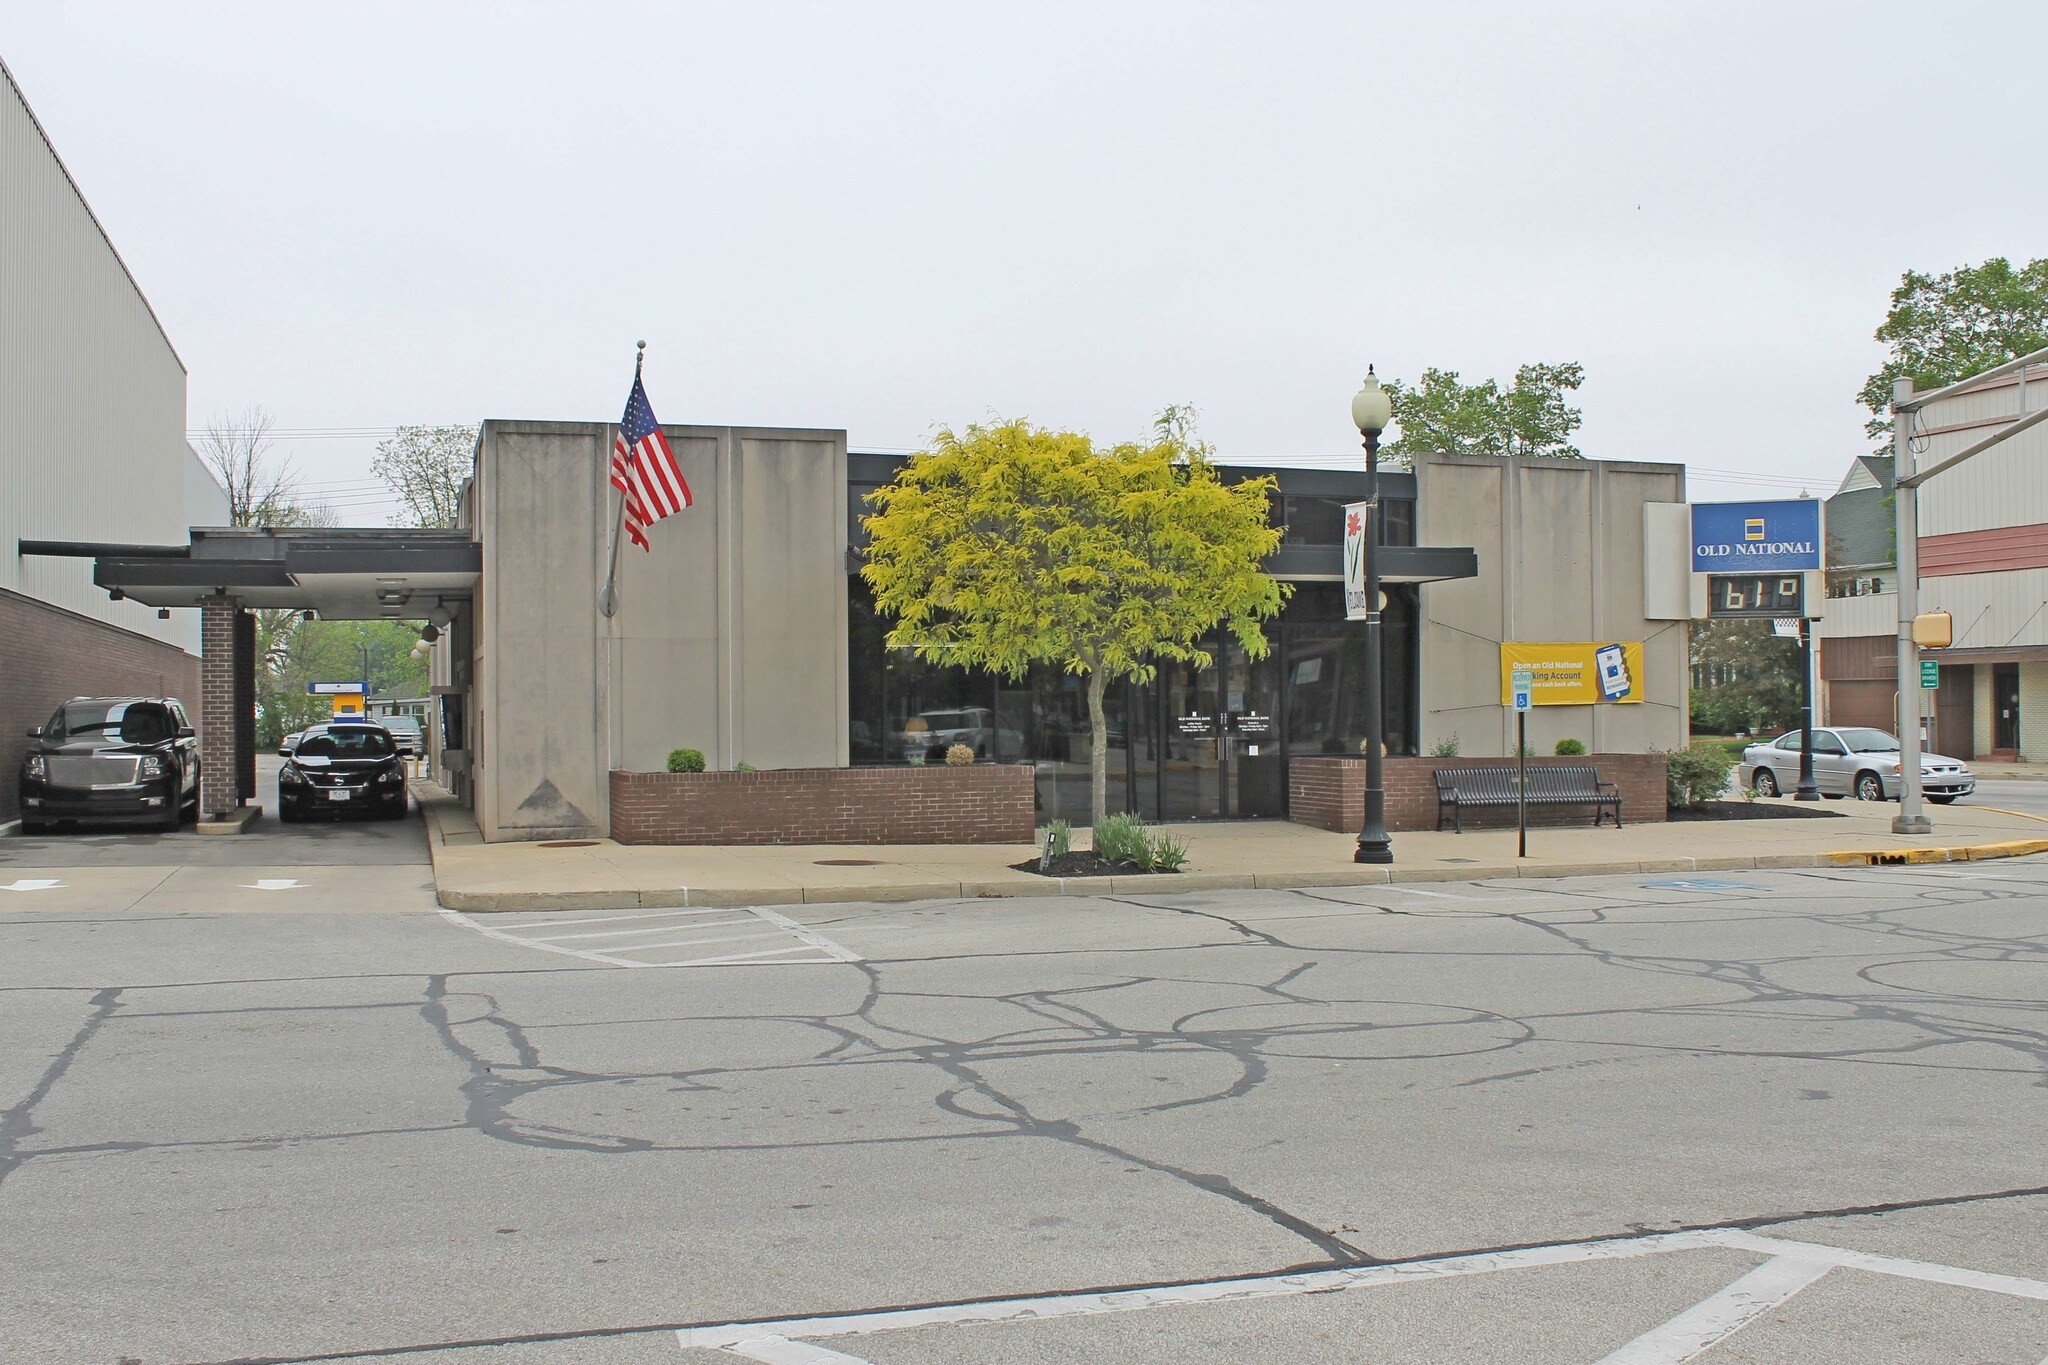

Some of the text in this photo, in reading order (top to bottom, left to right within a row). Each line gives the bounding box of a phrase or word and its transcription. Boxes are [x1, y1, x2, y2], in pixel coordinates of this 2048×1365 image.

[1697, 541, 1815, 556] OLD NATIONAL
[1513, 662, 1531, 670] Open
[1542, 661, 1554, 669] Old
[1555, 661, 1583, 669] National
[1550, 672, 1581, 680] Account
